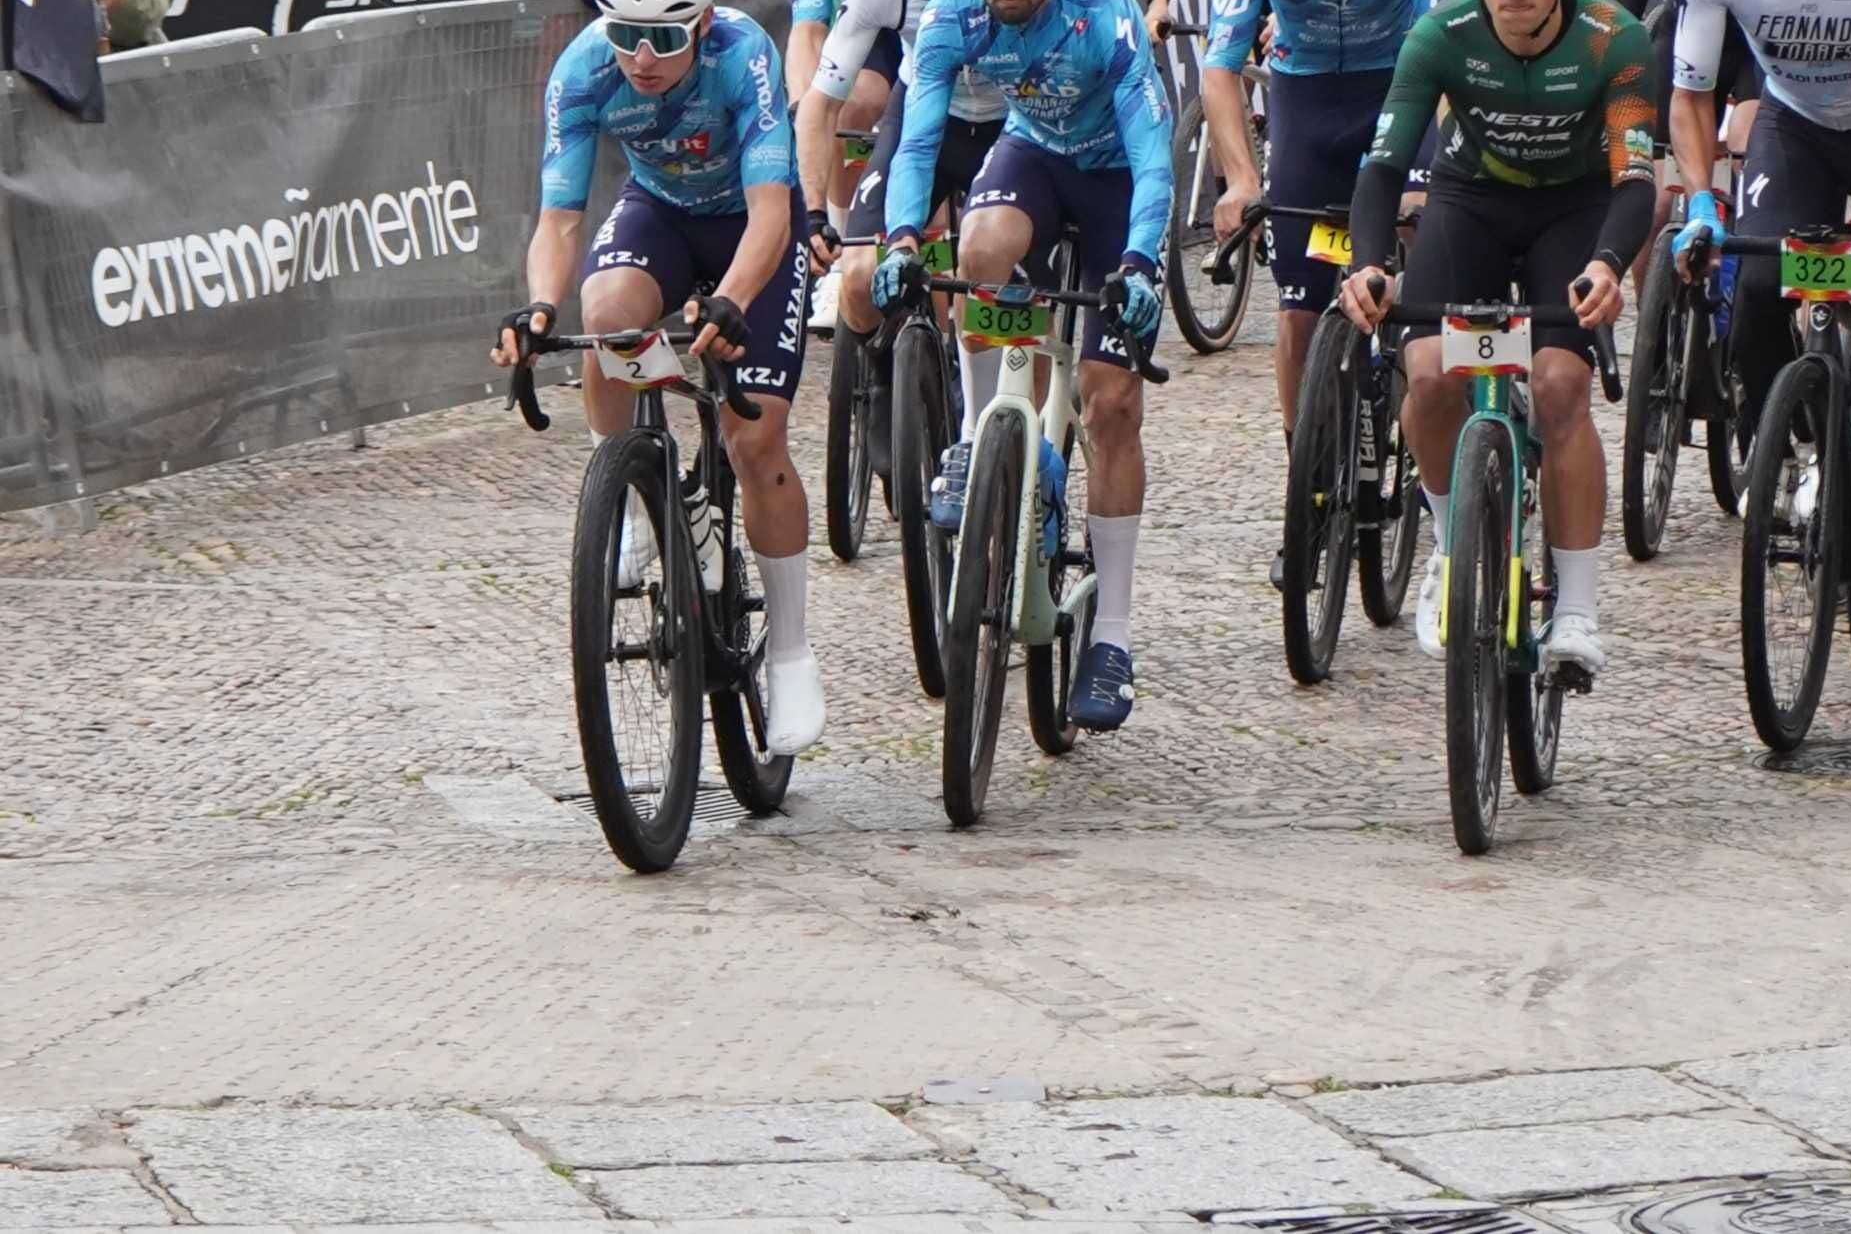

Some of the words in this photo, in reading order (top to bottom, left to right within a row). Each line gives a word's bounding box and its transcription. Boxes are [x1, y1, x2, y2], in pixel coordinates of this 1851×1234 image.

[970, 189, 1018, 207] KZJ
[92, 161, 479, 326] extremeñamente
[598, 250, 649, 268] KZJ
[1795, 255, 1847, 284] 322
[777, 241, 810, 354] KAZAJOZ
[977, 306, 1034, 332] 303
[1477, 335, 1495, 360] 8
[625, 361, 646, 379] 2
[735, 366, 787, 388] KZJ
